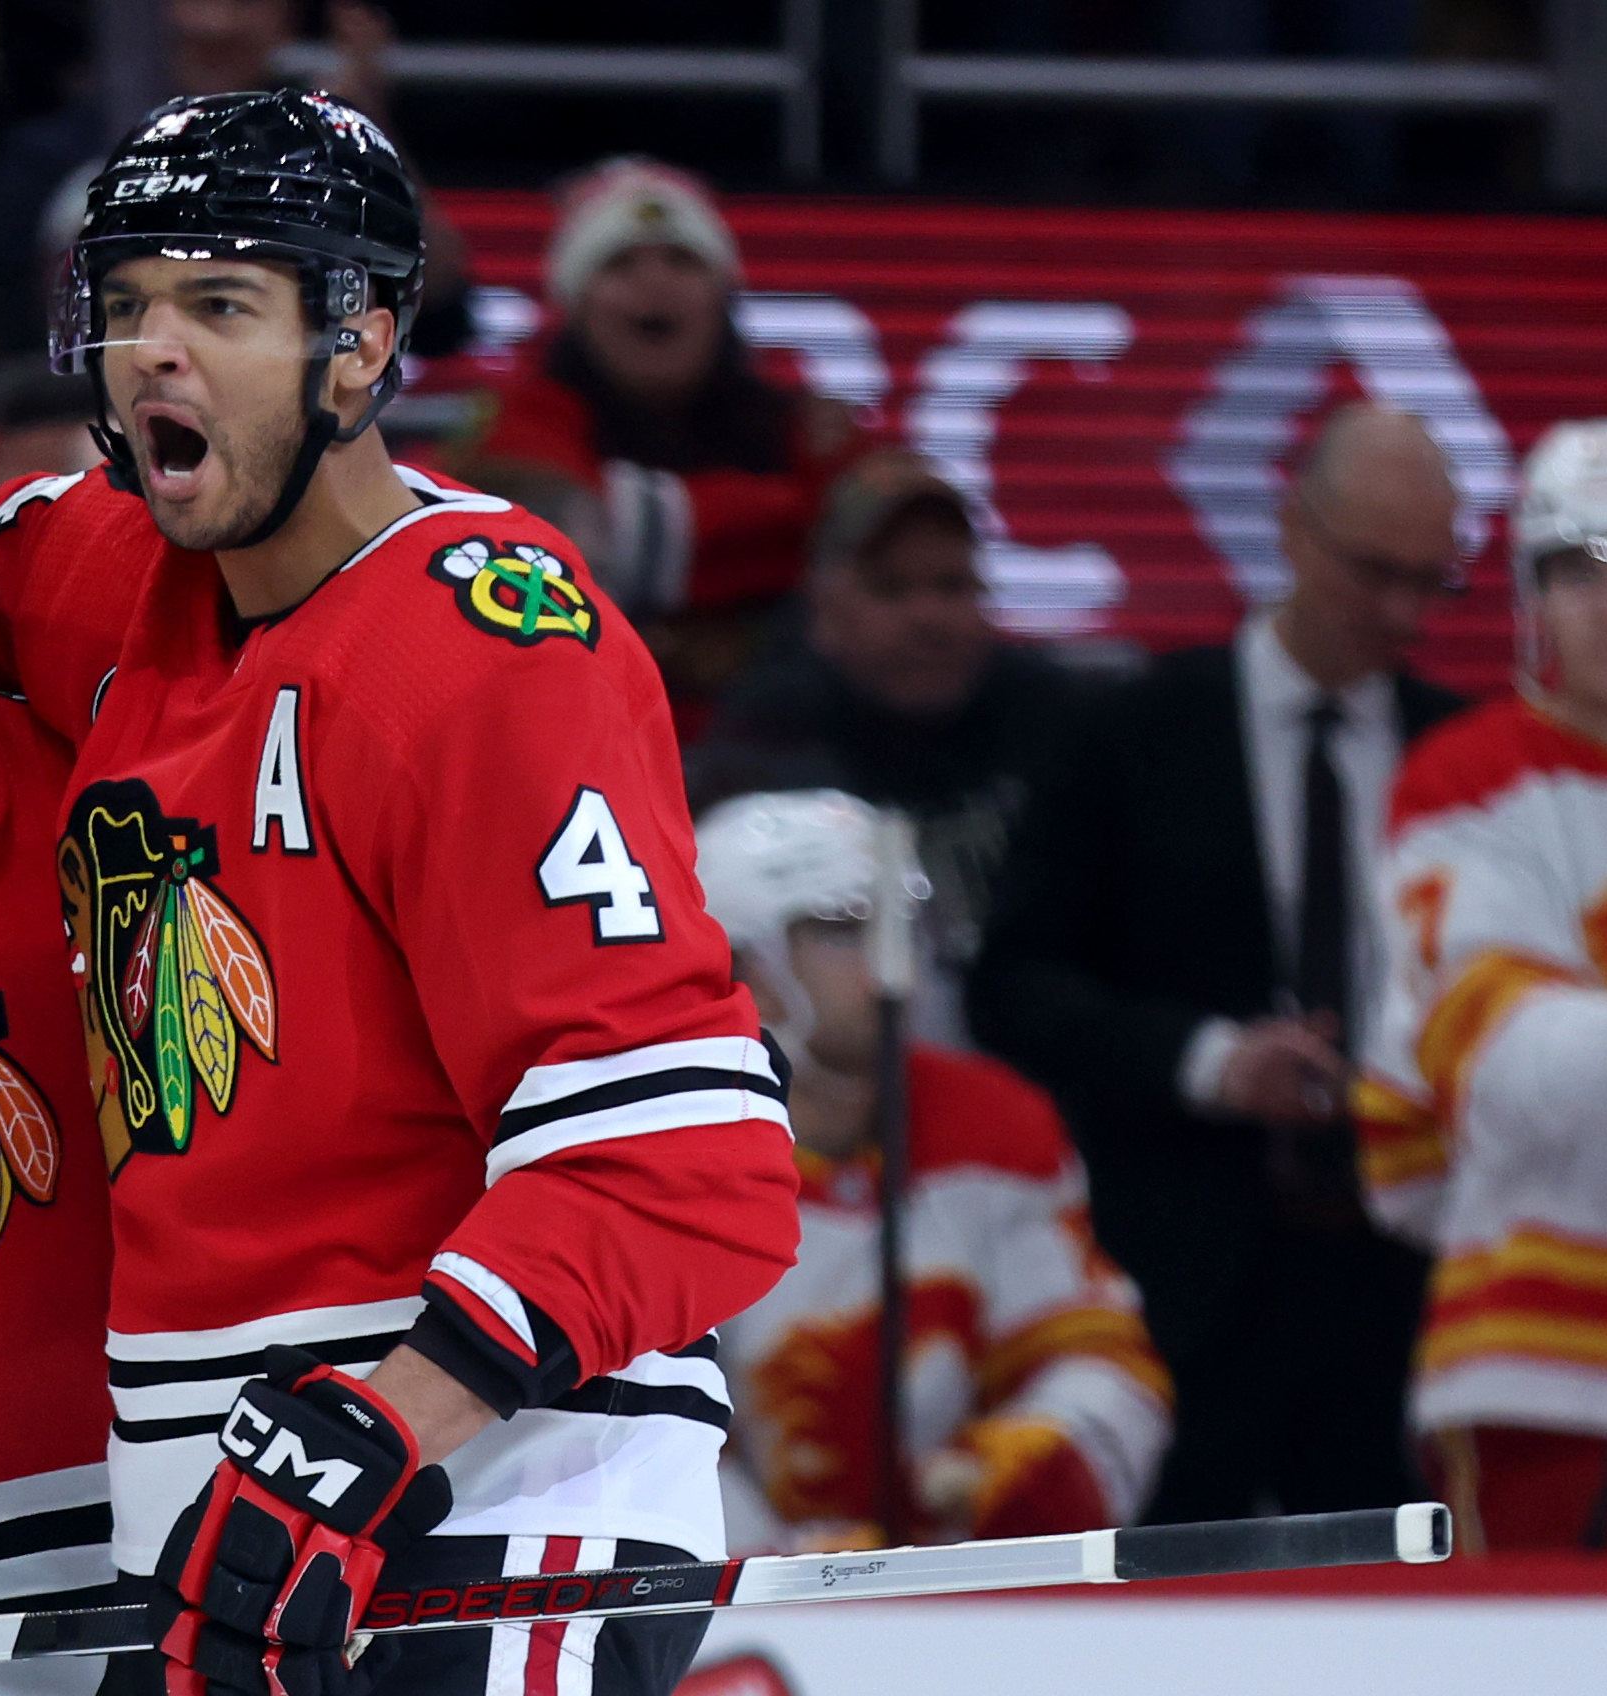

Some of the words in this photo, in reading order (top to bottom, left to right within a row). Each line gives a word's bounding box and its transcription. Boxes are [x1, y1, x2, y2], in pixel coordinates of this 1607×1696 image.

[113, 172, 209, 200] CCM
[250, 685, 314, 855] A
[536, 785, 663, 943] 4
[341, 1402, 376, 1429] JONES
[652, 1576, 686, 1591] PRO
